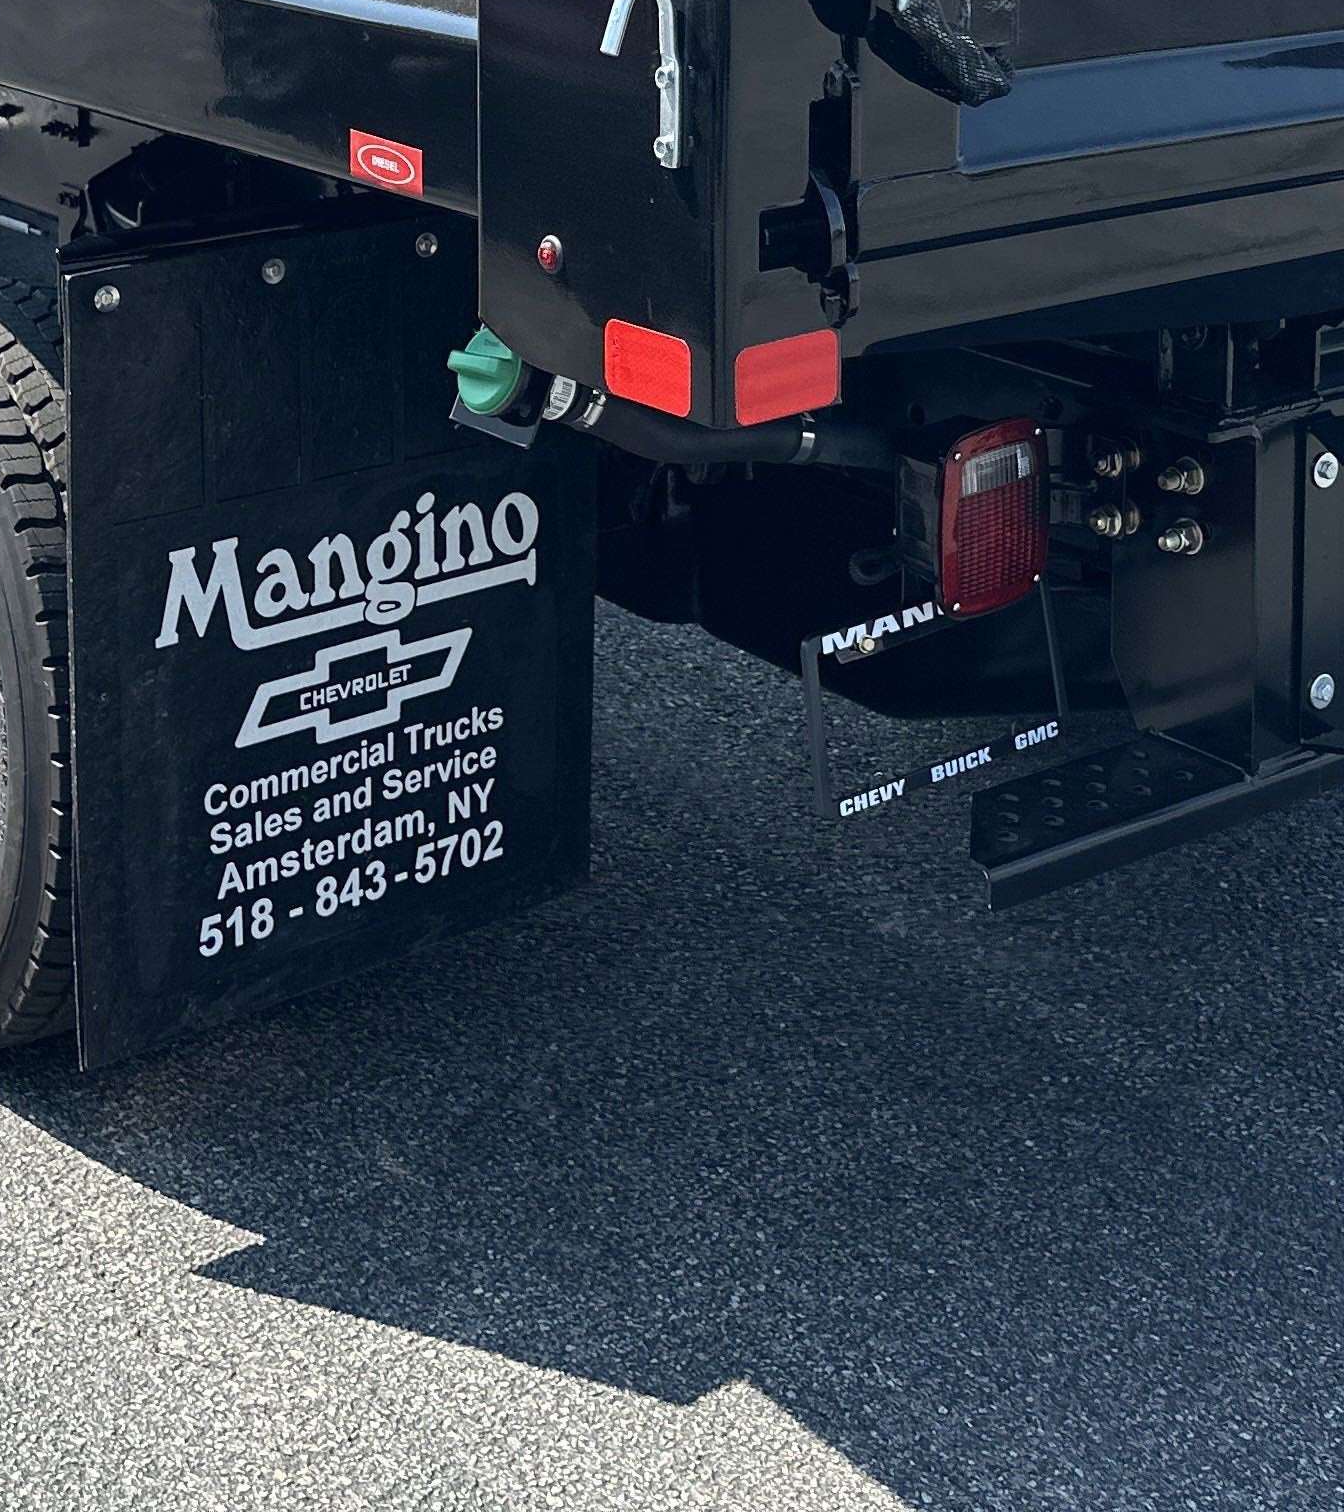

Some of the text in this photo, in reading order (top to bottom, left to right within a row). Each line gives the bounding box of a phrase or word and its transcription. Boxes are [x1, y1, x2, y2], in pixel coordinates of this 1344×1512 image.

[155, 492, 538, 650] Mangino
[822, 601, 945, 655] MAN
[300, 664, 411, 710] CHEVROLET
[204, 707, 504, 816] Commercial Trucks
[209, 746, 497, 855] Sales and Service
[839, 721, 1059, 817] CHEVY BUICK GMC
[218, 777, 495, 900] Amsterdam, NY
